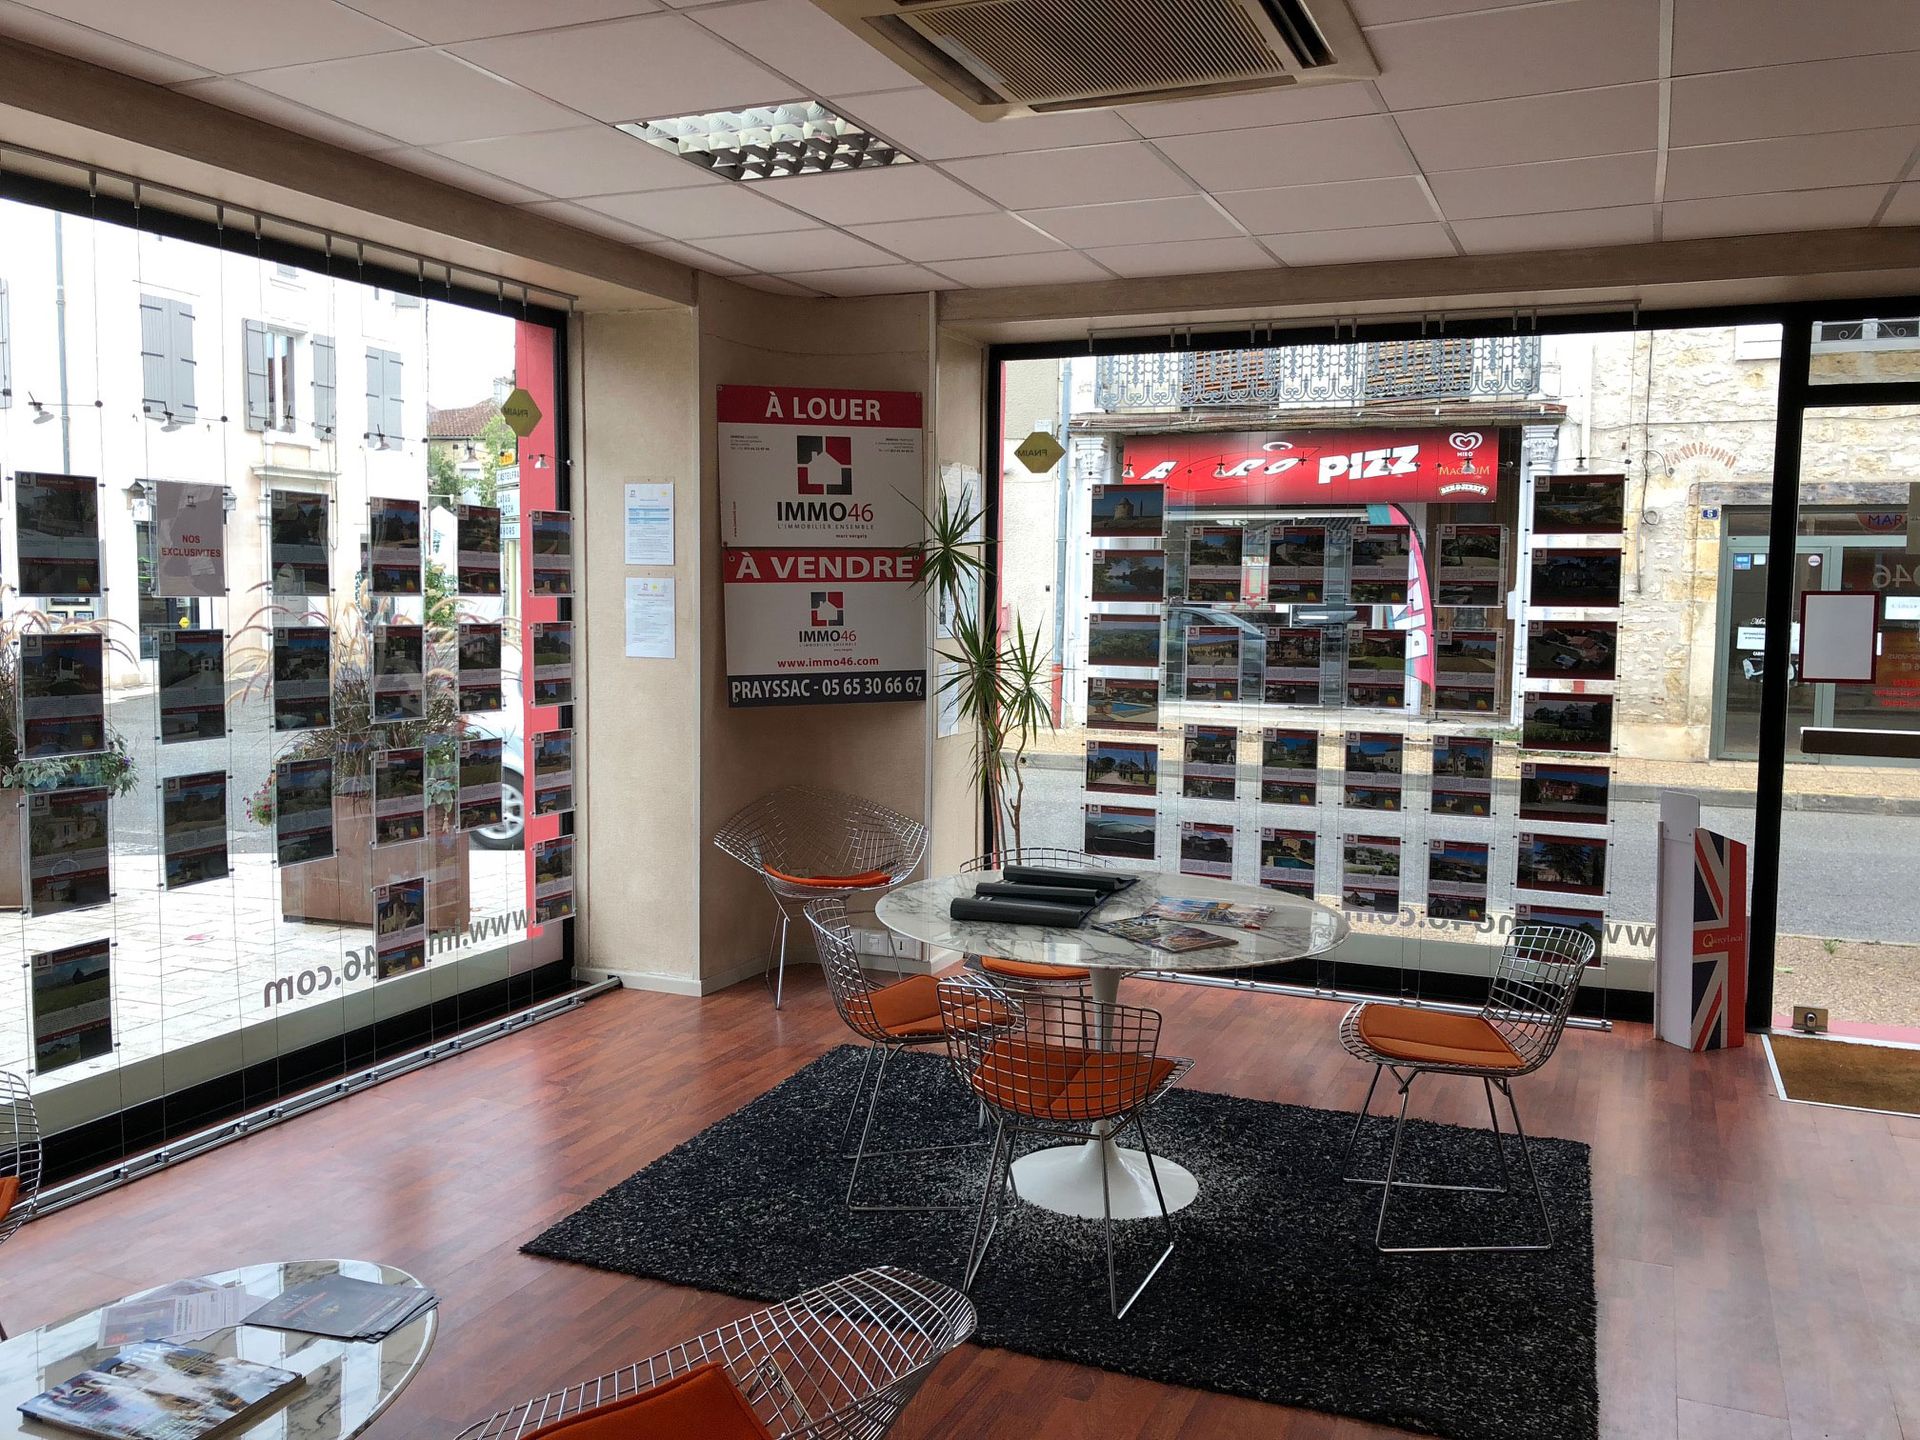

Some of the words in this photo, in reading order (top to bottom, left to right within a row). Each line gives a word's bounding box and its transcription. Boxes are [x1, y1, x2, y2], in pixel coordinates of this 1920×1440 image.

[764, 391, 784, 418] À
[793, 397, 881, 421] LOUER
[1318, 445, 1420, 484] PIZZ
[1439, 466, 1490, 476] MAGUM
[776, 501, 874, 522] IMMO46
[181, 534, 201, 544] NOS
[736, 551, 761, 579] À
[769, 556, 914, 579] VENDRE
[799, 629, 857, 643] IMMO46
[777, 656, 879, 668] www.immo46.com
[731, 679, 811, 699] PRAYSSAC
[822, 678, 840, 696] 05
[843, 678, 861, 695] 65
[864, 677, 882, 694] 30
[884, 677, 902, 693] 66
[905, 676, 922, 693] 67
